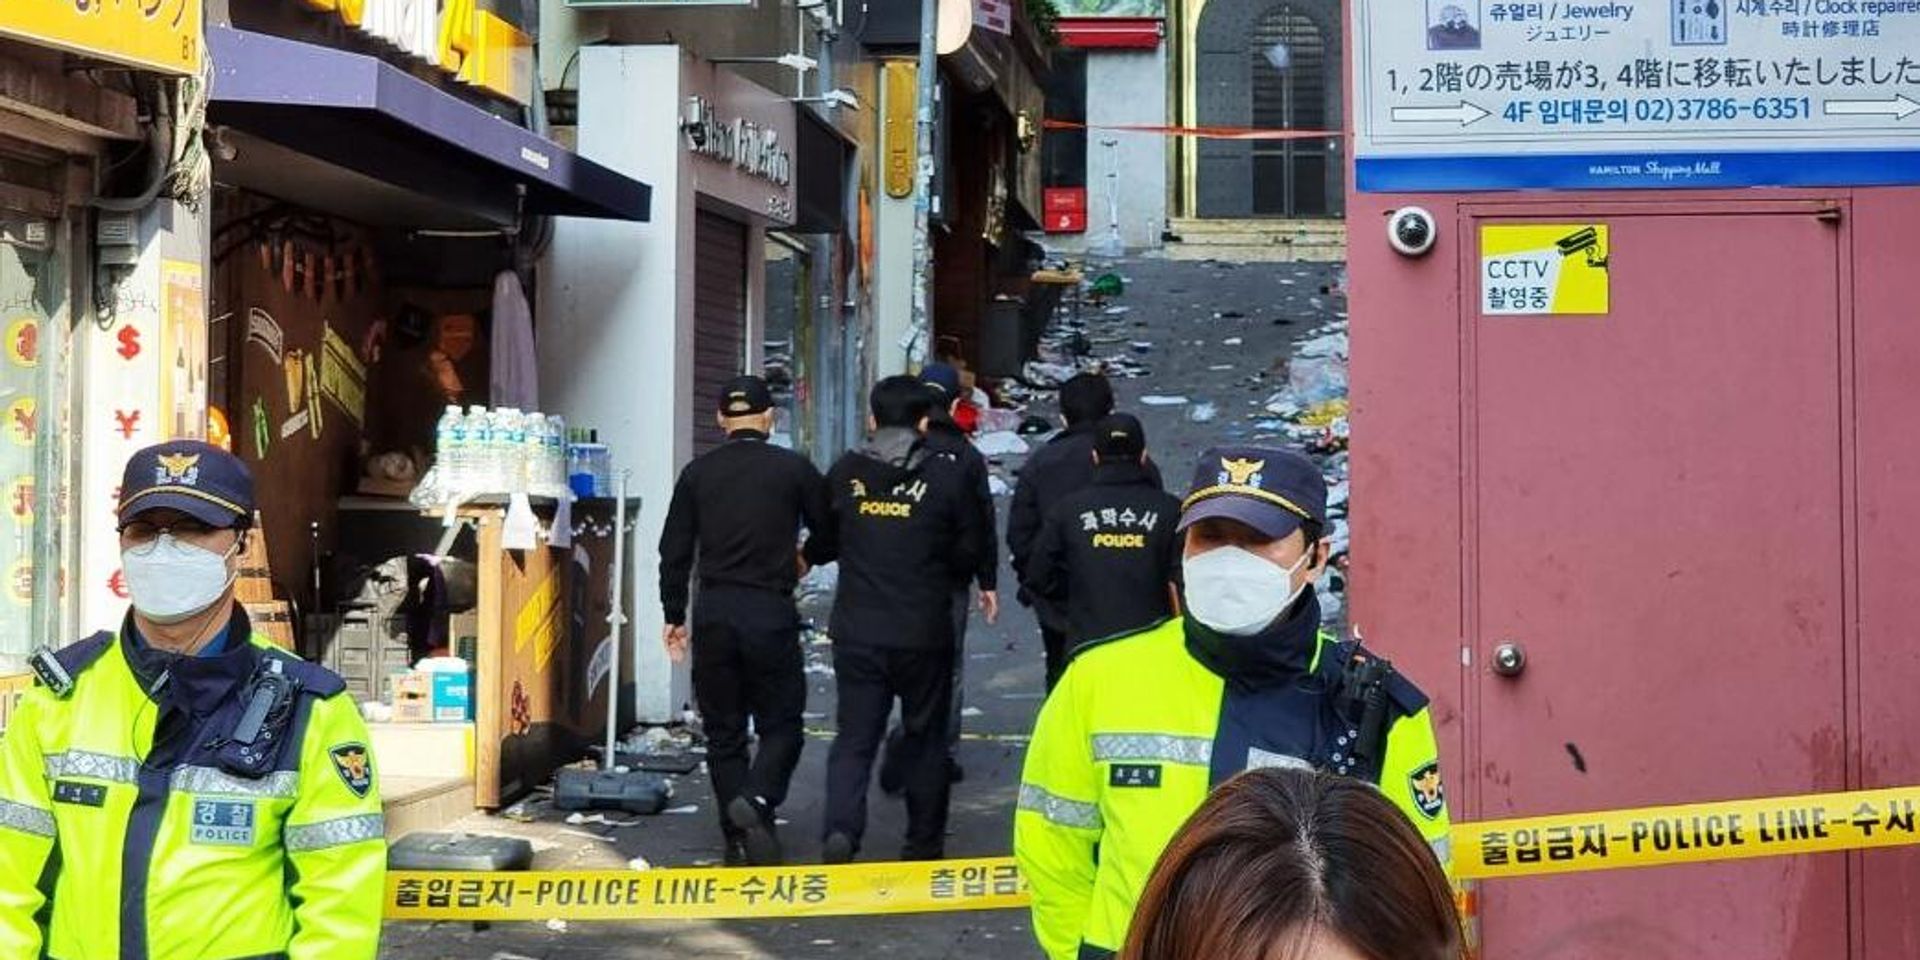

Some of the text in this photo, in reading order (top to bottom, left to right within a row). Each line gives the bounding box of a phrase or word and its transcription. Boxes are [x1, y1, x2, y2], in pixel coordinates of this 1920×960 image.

[1561, 2, 1634, 21] Jewelry
[1815, 0, 1857, 14] Clock
[1526, 24, 1611, 42] ジュエリー
[1781, 20, 1880, 38] 時計修理店
[1502, 96, 1810, 125] 4F 임대문의 02)3786-6351
[1588, 165, 1642, 175] HAMILTON
[1487, 260, 1549, 279] CCTV
[1487, 286, 1549, 309] 촬영중
[859, 501, 912, 518] POLICE
[1092, 533, 1145, 549] POLICE
[197, 802, 249, 826] 경찰
[194, 829, 249, 841] POLICE
[1481, 814, 1745, 866] 출입금지-POLICE
[396, 873, 828, 908] 출입금지-POLICE LINE-수사중
[930, 865, 1028, 899] 출입금
